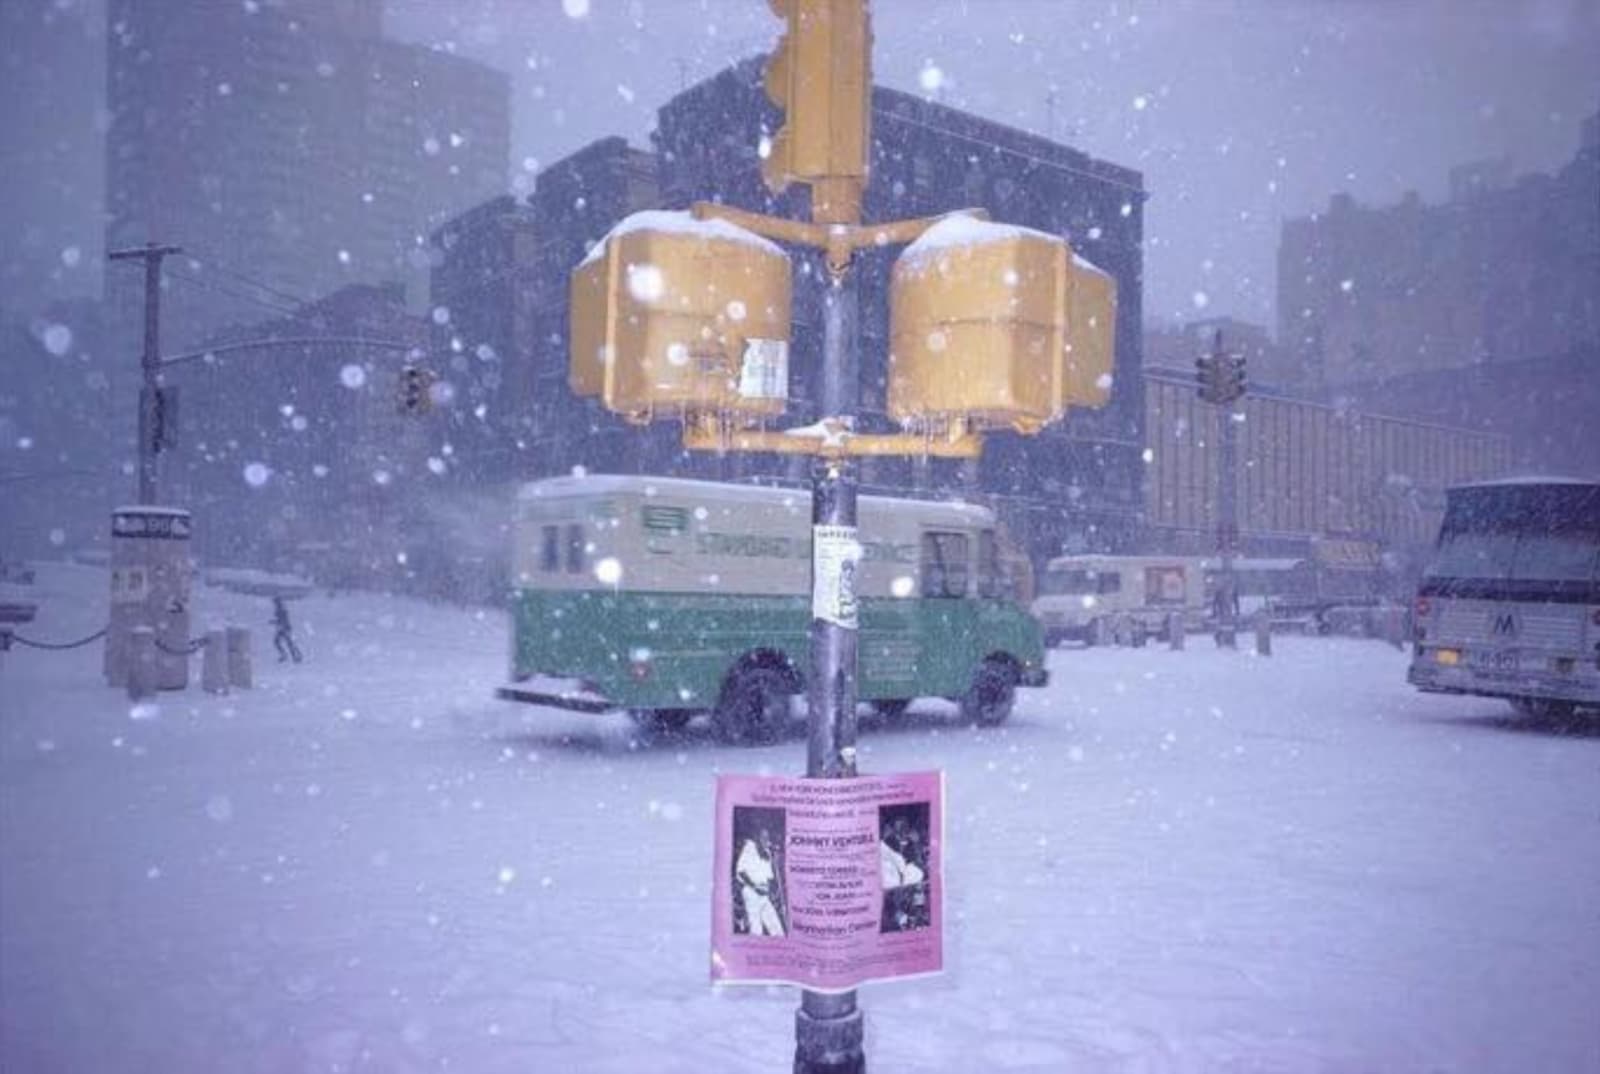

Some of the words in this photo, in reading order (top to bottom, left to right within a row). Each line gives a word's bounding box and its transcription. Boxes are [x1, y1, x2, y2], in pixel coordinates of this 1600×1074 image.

[1494, 614, 1515, 635] M
[790, 836, 830, 847] JOHNNY
[832, 833, 874, 847] VENTURA
